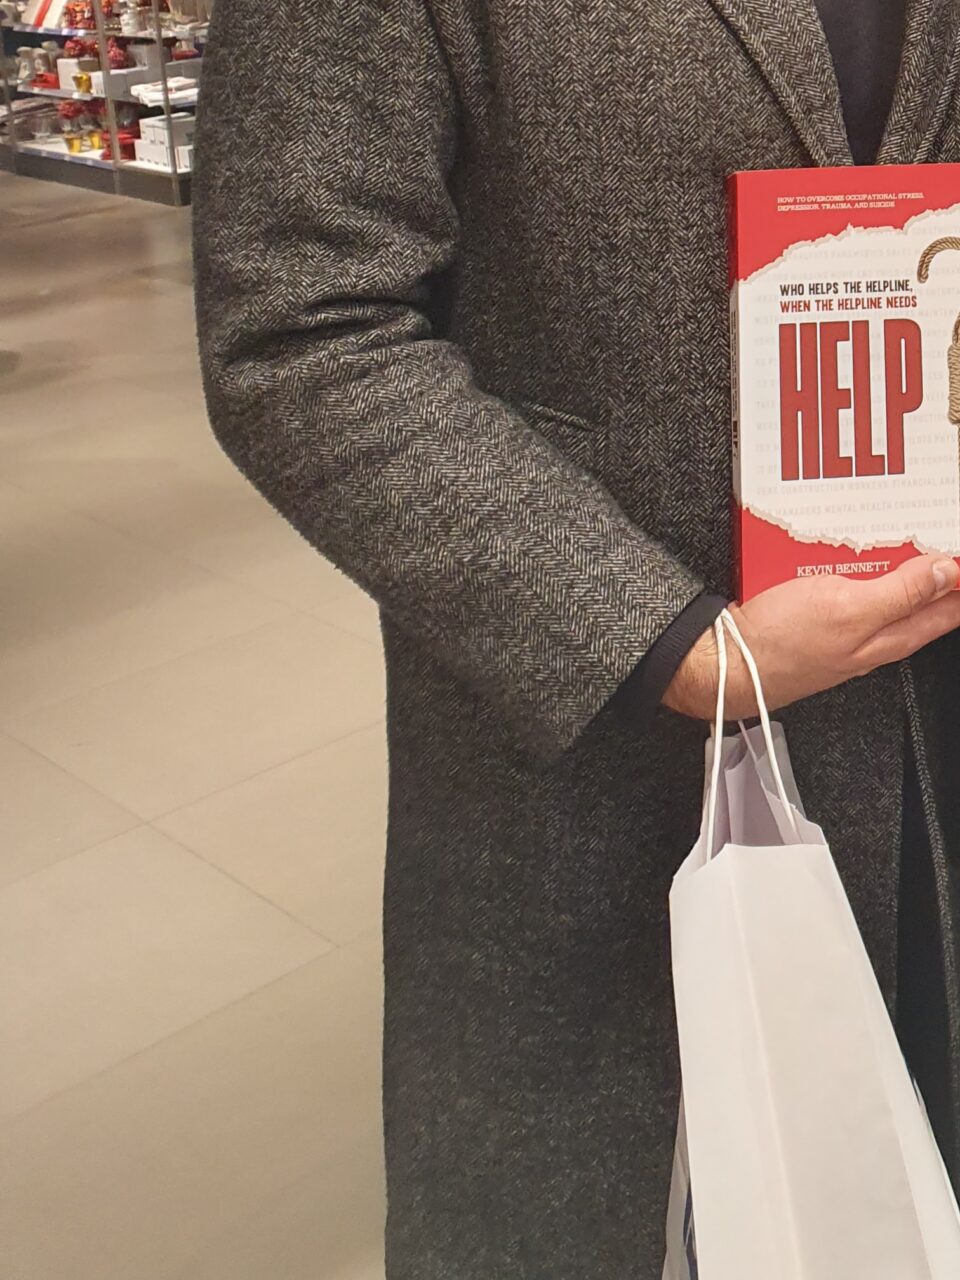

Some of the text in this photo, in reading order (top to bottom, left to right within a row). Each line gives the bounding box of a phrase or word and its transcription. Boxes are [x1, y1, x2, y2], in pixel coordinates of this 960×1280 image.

[777, 196, 794, 204] HOW
[807, 194, 845, 203] OVERCOME
[845, 193, 897, 202] OCCUPATIONAL
[854, 201, 868, 209] AND
[869, 200, 895, 208] SUICIDE
[779, 282, 805, 297] WHO
[808, 281, 839, 296] HELPS
[843, 280, 862, 294] THE
[866, 279, 913, 294] HELPLINE,
[780, 295, 917, 313] WHEN THE HELPLINE NEEDS
[778, 317, 924, 482] HELP
[796, 560, 891, 577] KEVIN BENNETT
